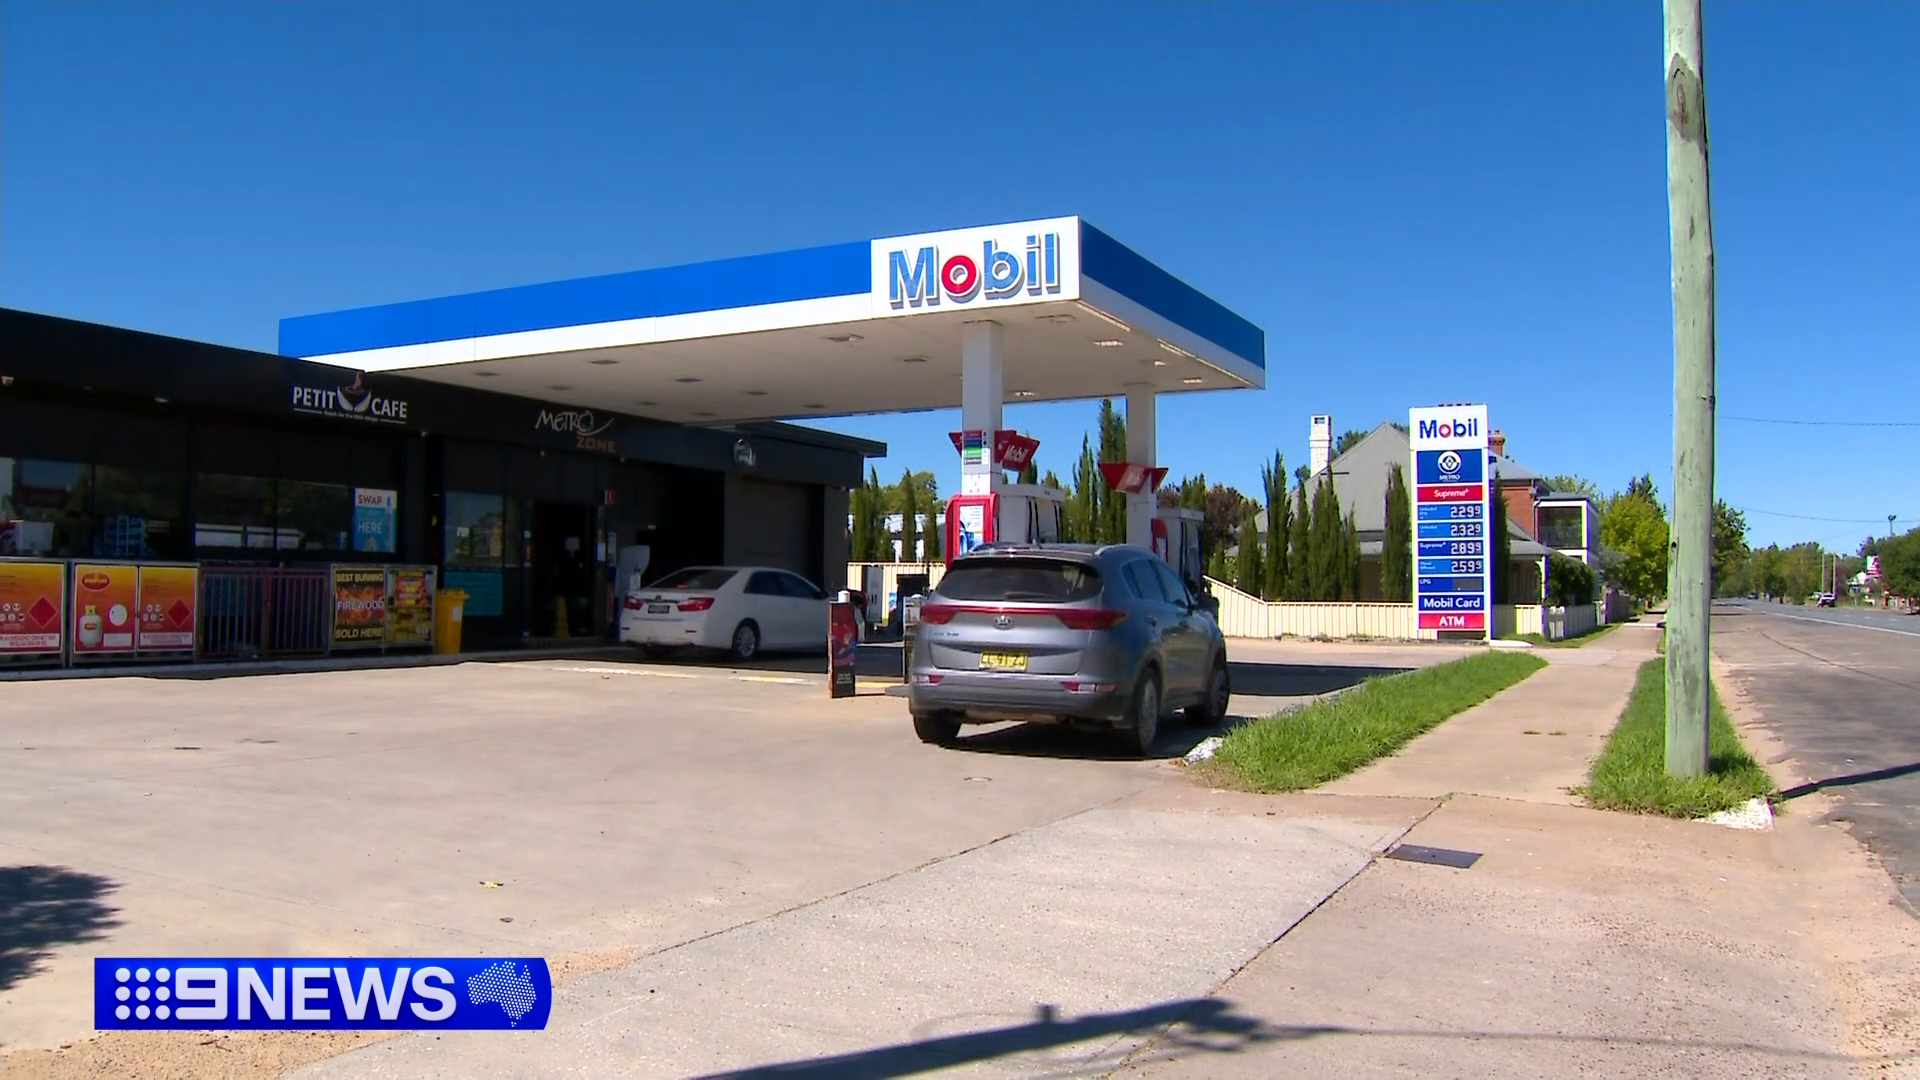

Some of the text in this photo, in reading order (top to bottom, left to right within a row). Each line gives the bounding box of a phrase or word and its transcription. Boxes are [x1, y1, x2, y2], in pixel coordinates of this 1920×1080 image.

[888, 232, 1060, 309] Mobil
[292, 386, 336, 409] PETIT
[371, 398, 408, 418] CAFE
[1419, 418, 1478, 438] Mobil
[576, 437, 617, 453] ZONE
[1003, 444, 1029, 463] Mobil
[358, 494, 383, 505] SWAP
[358, 521, 383, 534] HERE
[336, 573, 354, 582] BEST
[337, 600, 384, 610] FIREWOOD
[1424, 597, 1480, 608] Mobil Card
[1439, 616, 1465, 626] ATM
[335, 628, 383, 639] SOLD HERE
